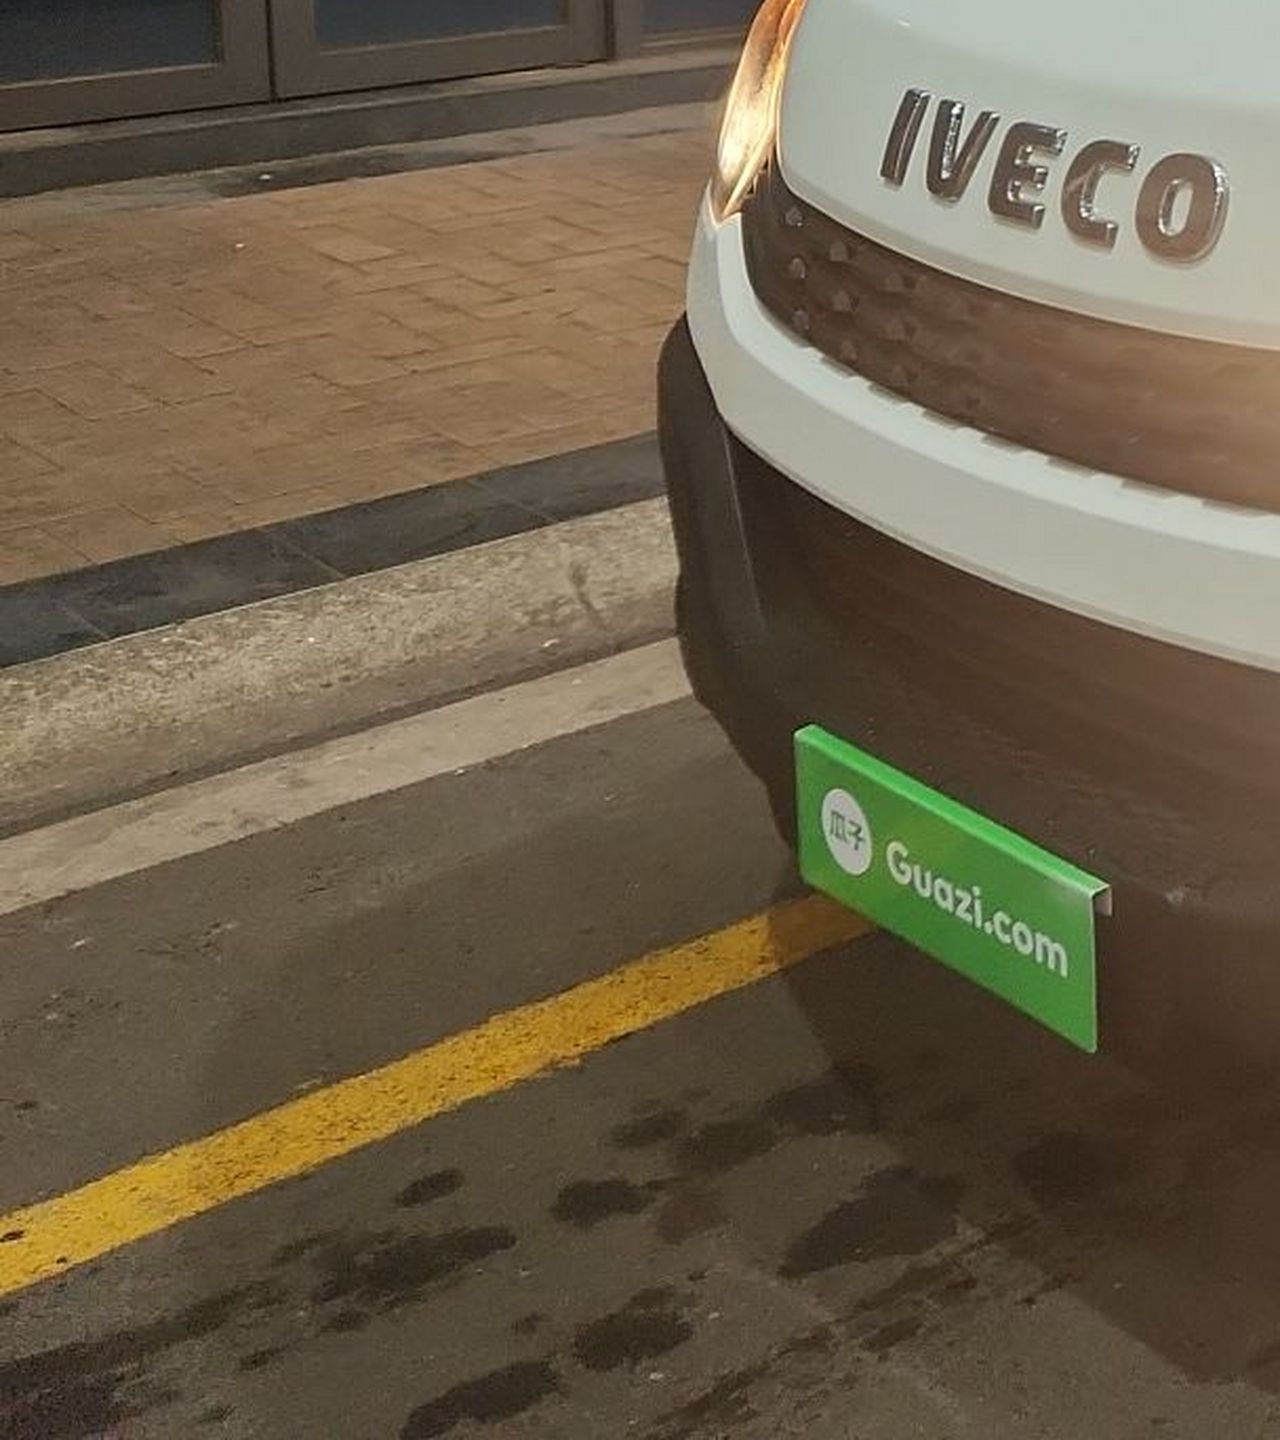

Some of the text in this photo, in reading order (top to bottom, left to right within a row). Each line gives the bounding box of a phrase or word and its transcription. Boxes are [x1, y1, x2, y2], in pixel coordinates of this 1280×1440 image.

[879, 87, 1230, 264] IVECO
[828, 809, 866, 852] 瓜子
[886, 841, 1069, 978] Guazi.com
